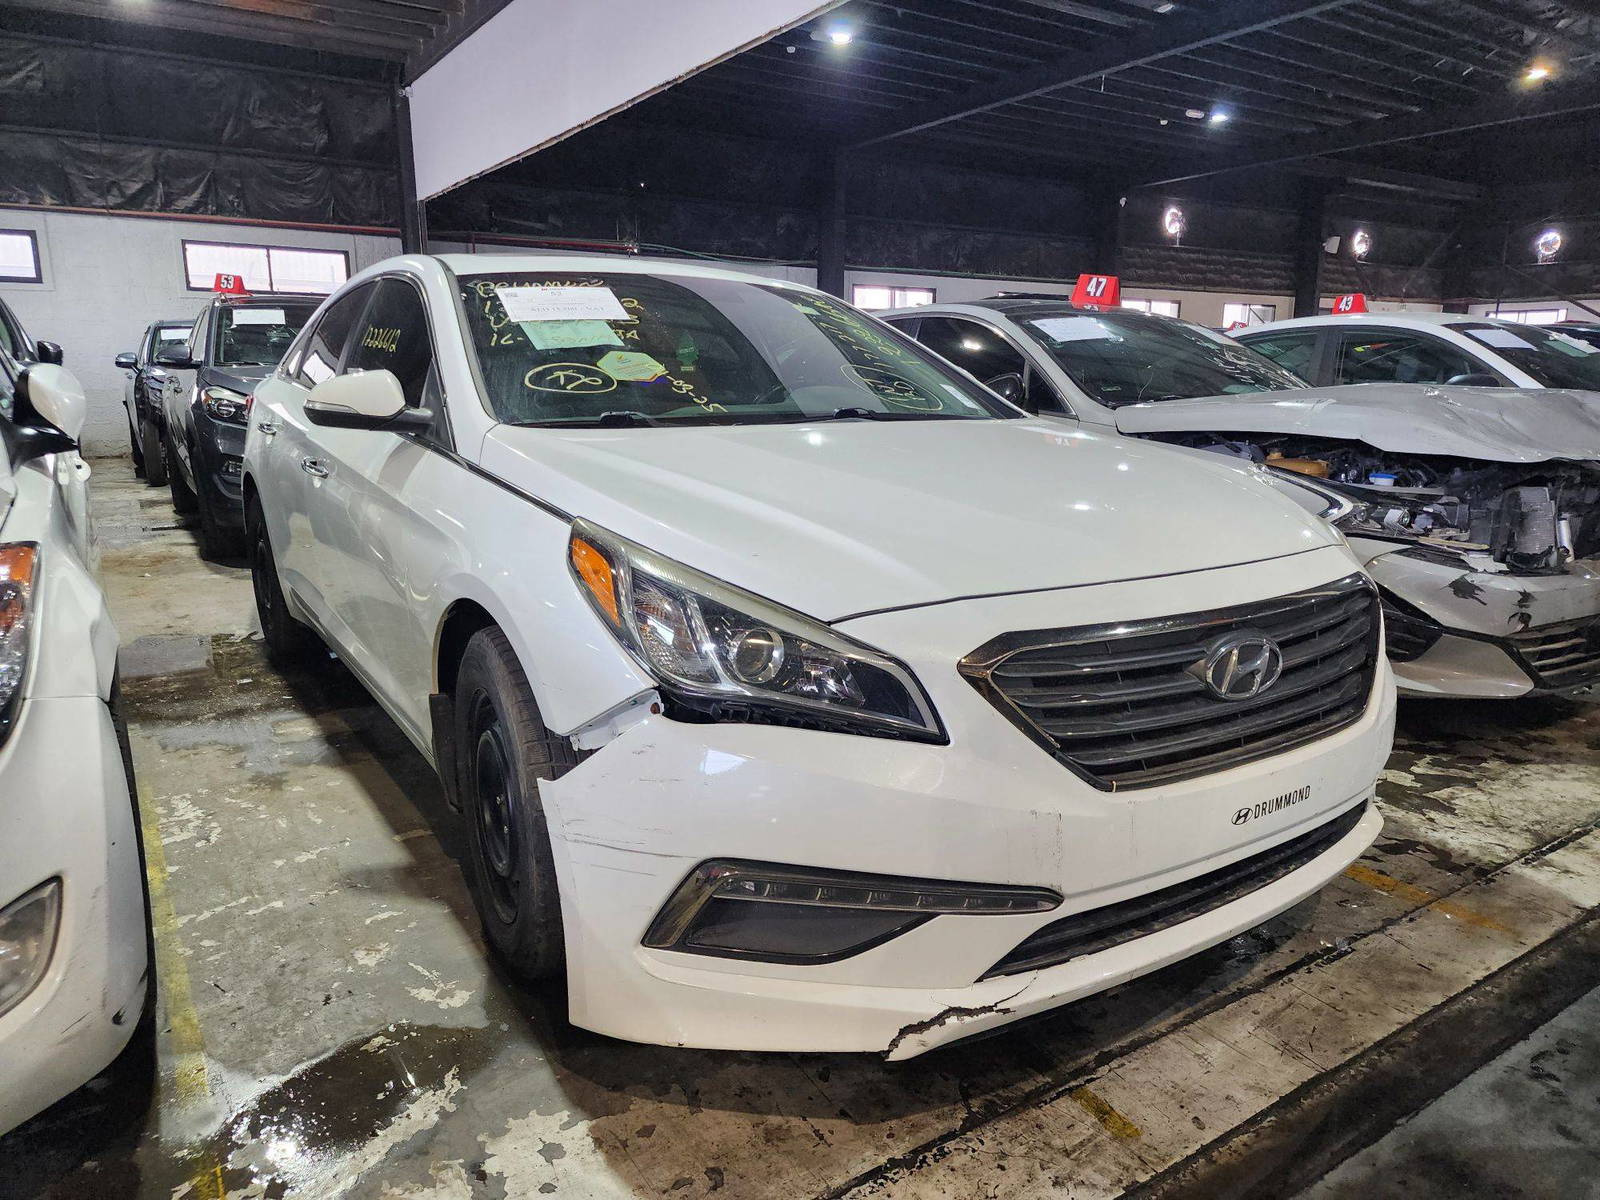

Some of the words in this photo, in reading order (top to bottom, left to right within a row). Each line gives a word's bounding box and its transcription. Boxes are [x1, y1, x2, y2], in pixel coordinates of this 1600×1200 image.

[221, 275, 234, 288] 53
[1087, 277, 1107, 296] 47
[1339, 295, 1354, 311] 43
[1254, 785, 1311, 819] DRUMMOND
